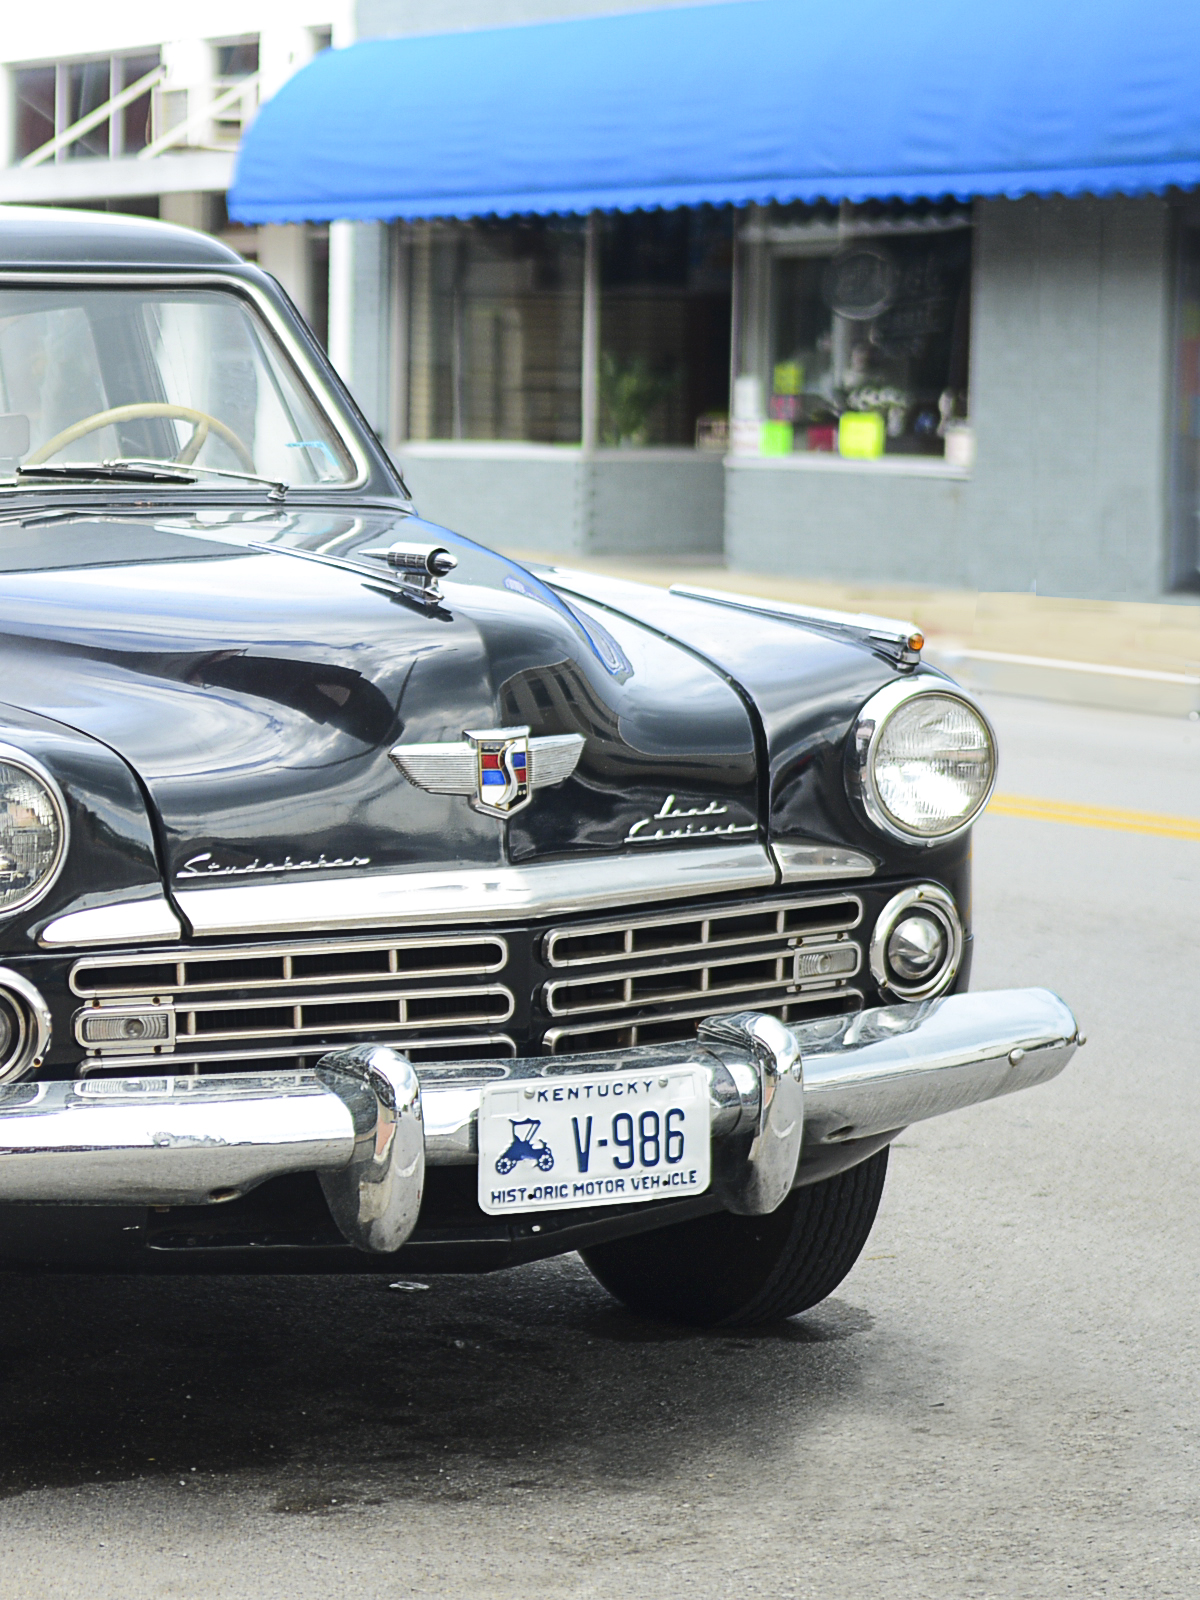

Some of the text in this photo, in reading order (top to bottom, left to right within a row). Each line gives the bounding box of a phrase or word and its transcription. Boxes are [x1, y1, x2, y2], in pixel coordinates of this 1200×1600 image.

[176, 853, 370, 878] Studebaker
[537, 1080, 652, 1102] KENTUCKY
[571, 1108, 685, 1173] V-986
[490, 1170, 697, 1204] HISTORIC MOTOR VEHICLE
